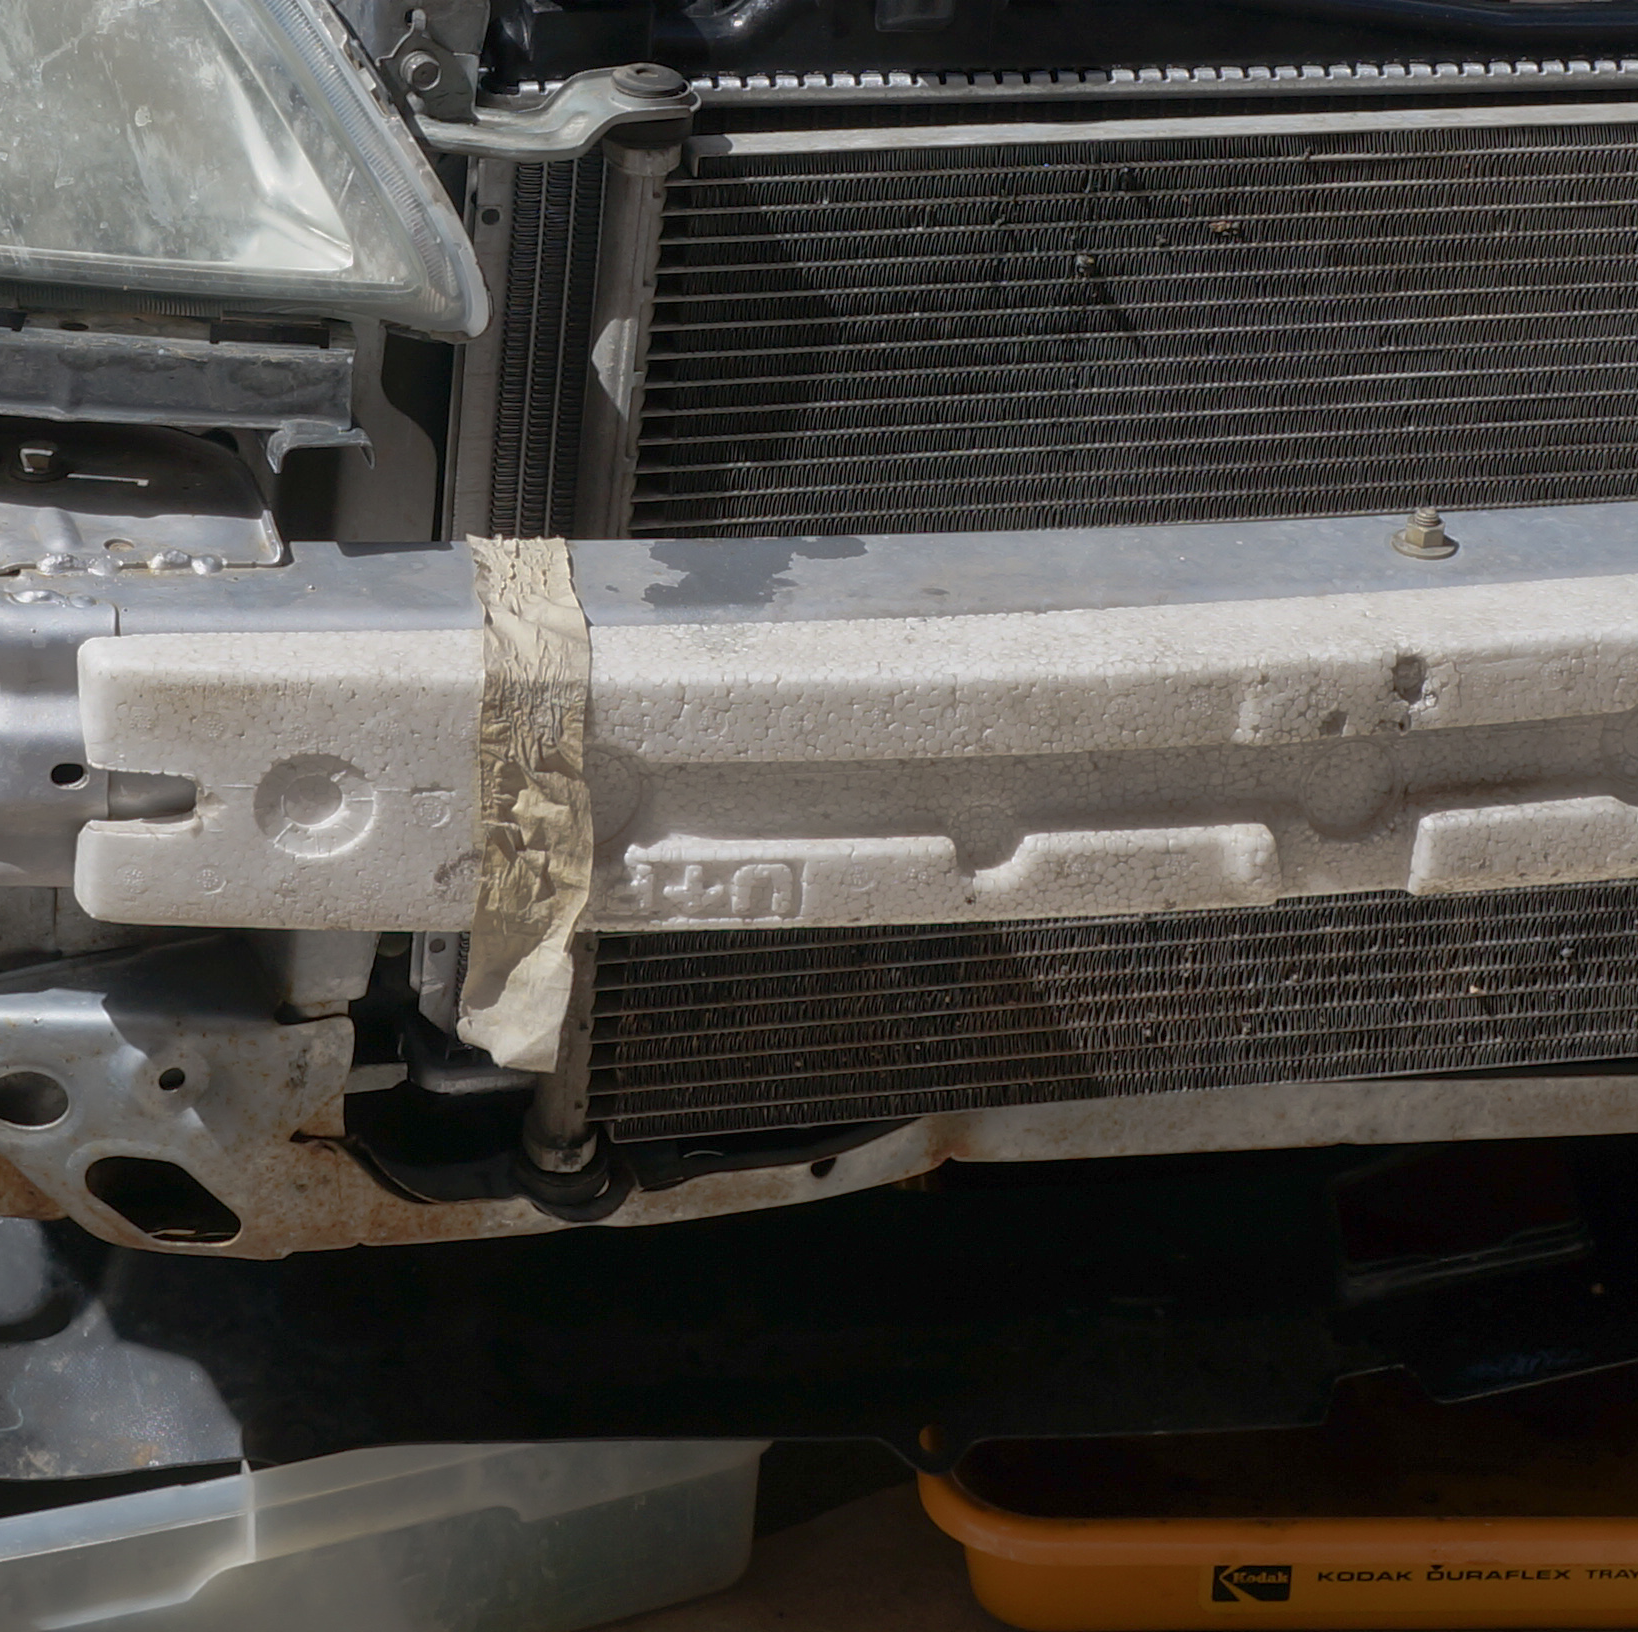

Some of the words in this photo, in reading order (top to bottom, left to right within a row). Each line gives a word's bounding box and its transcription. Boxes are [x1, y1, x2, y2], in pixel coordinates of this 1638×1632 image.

[1232, 1571, 1290, 1585] Kodak
[1317, 1570, 1412, 1583] KODAK
[1426, 1568, 1572, 1582] DURAFLEX
